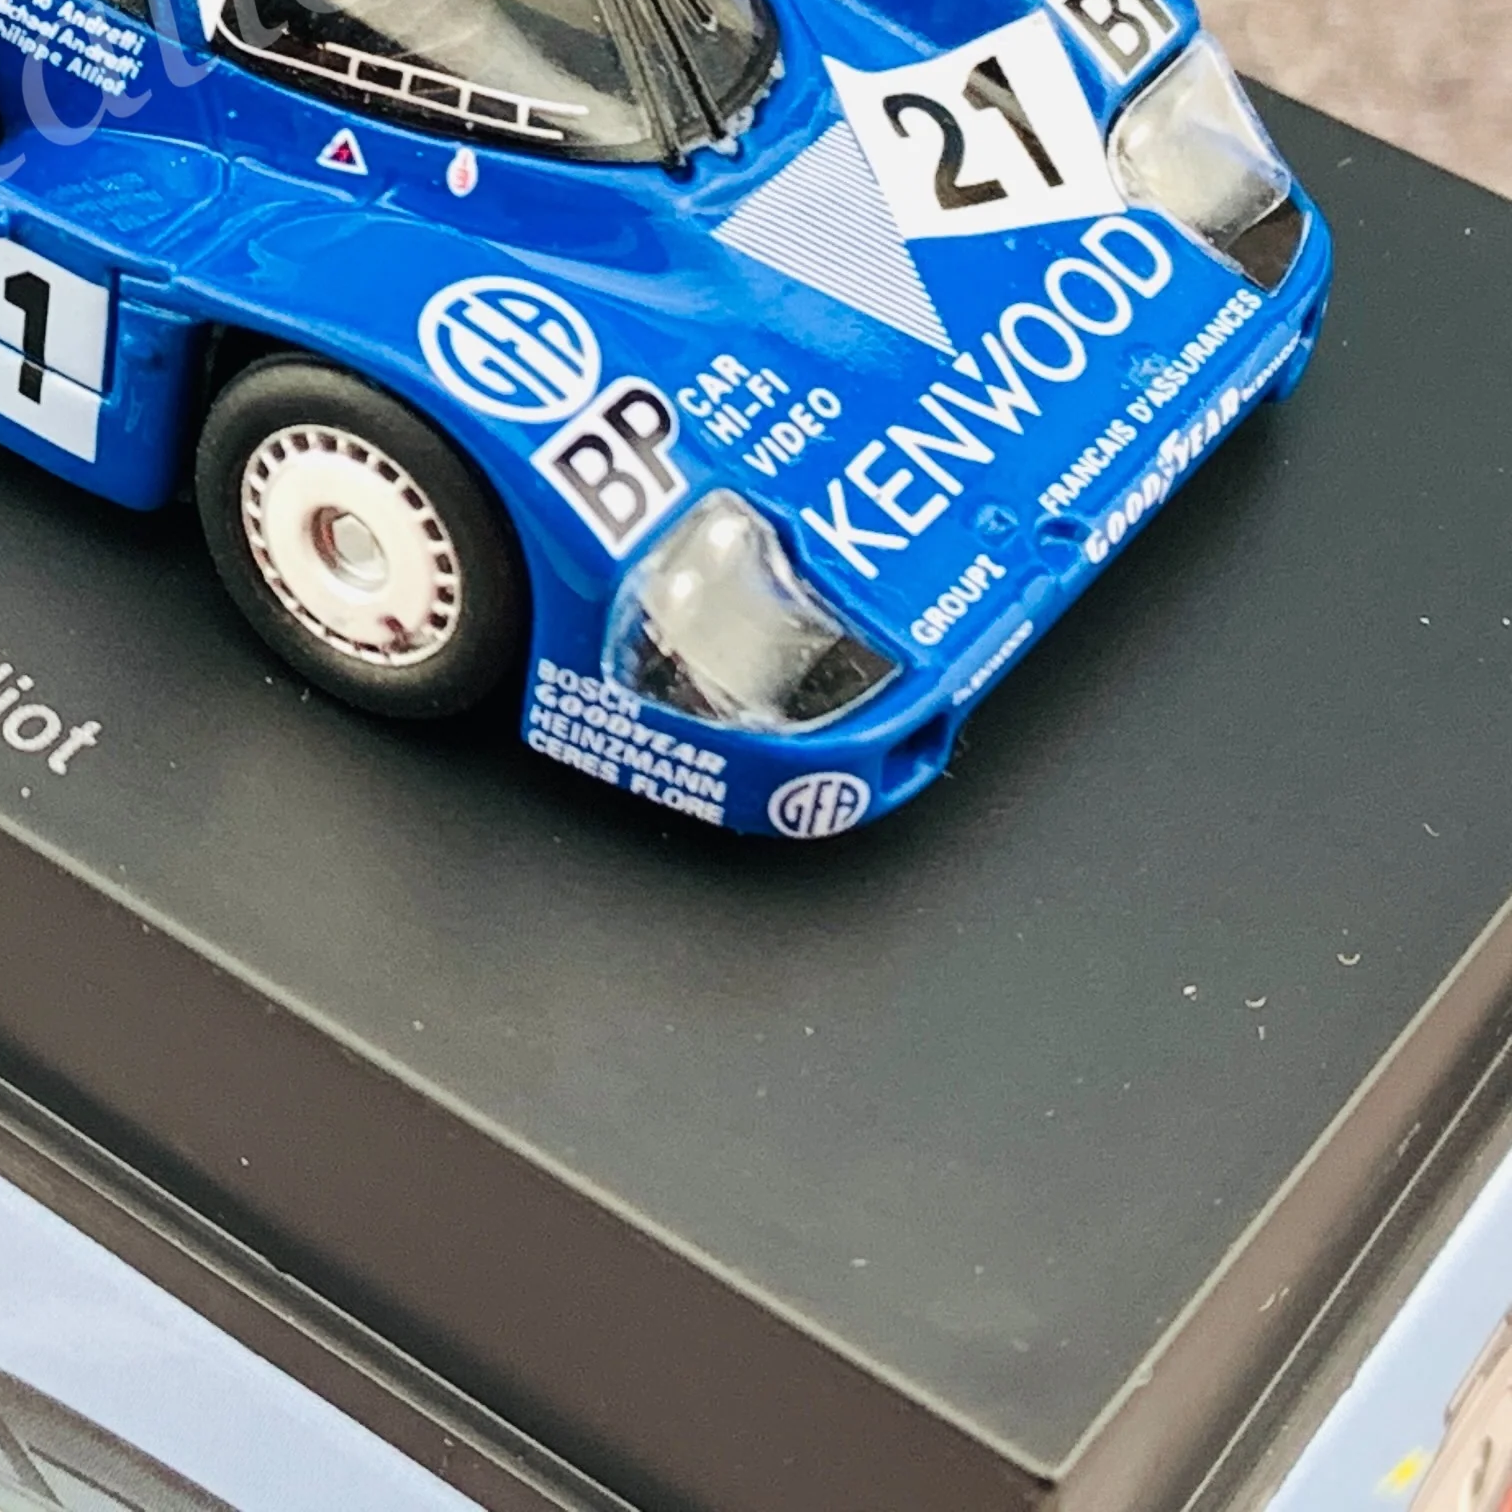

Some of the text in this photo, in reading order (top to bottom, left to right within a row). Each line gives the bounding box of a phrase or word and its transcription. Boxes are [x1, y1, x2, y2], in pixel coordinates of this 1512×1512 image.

[56, 0, 147, 56] Andretti
[57, 28, 144, 81] Andretti
[881, 54, 1065, 212] 21
[677, 353, 755, 420] CAR
[704, 368, 792, 447] HI-FI
[742, 386, 844, 478] VIDEO
[800, 215, 1174, 581] KENWOOD
[1038, 418, 1138, 517] FRANCAIS
[1126, 288, 1263, 424] D'ASSURANCES
[550, 387, 680, 548] BP
[533, 682, 729, 776] GOODYEAR
[536, 656, 642, 720] BOSCH
[527, 728, 726, 828] CERES FLORE
[529, 705, 728, 804] HEINZMANN
